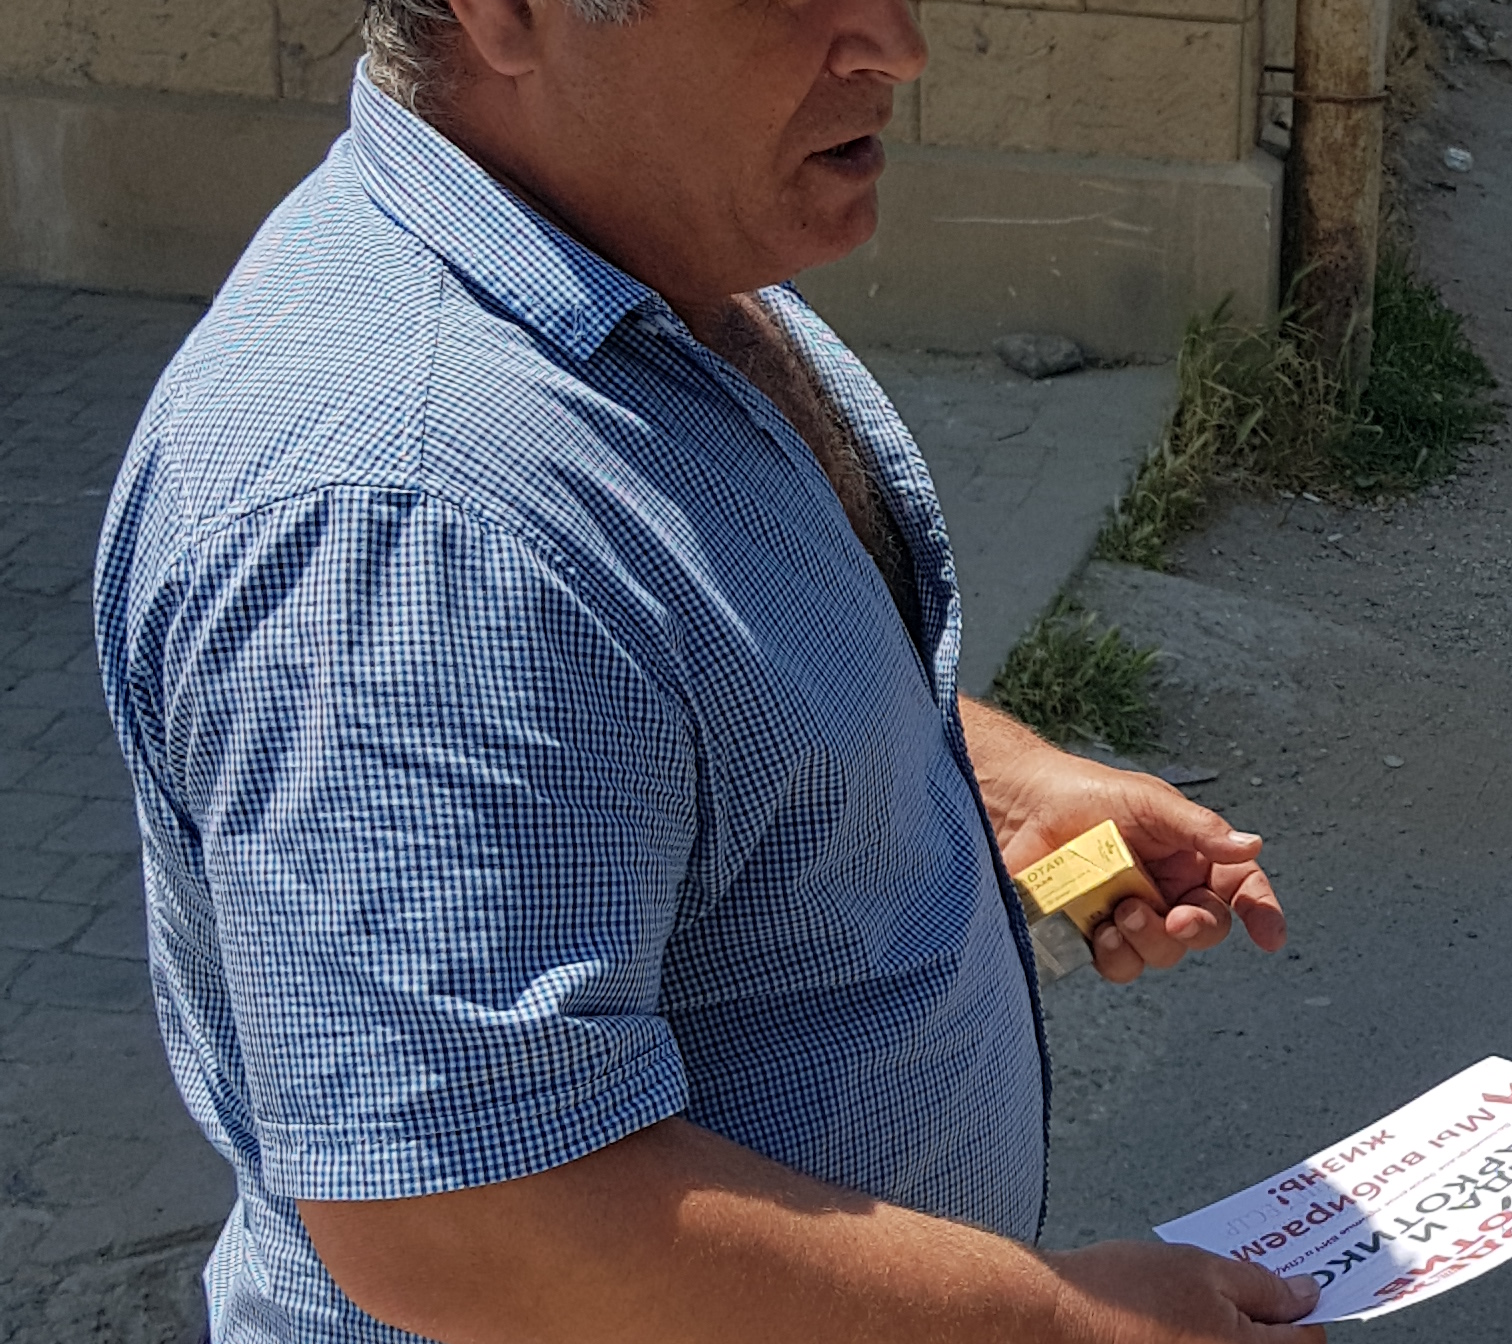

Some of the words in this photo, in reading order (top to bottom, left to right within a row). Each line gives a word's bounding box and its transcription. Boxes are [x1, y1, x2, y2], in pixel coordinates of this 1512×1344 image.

[1428, 1107, 1496, 1148] Мы
[1267, 1129, 1396, 1205] жизнь!
[1230, 1151, 1427, 1263] выбираем
[1408, 1221, 1447, 1243] И
